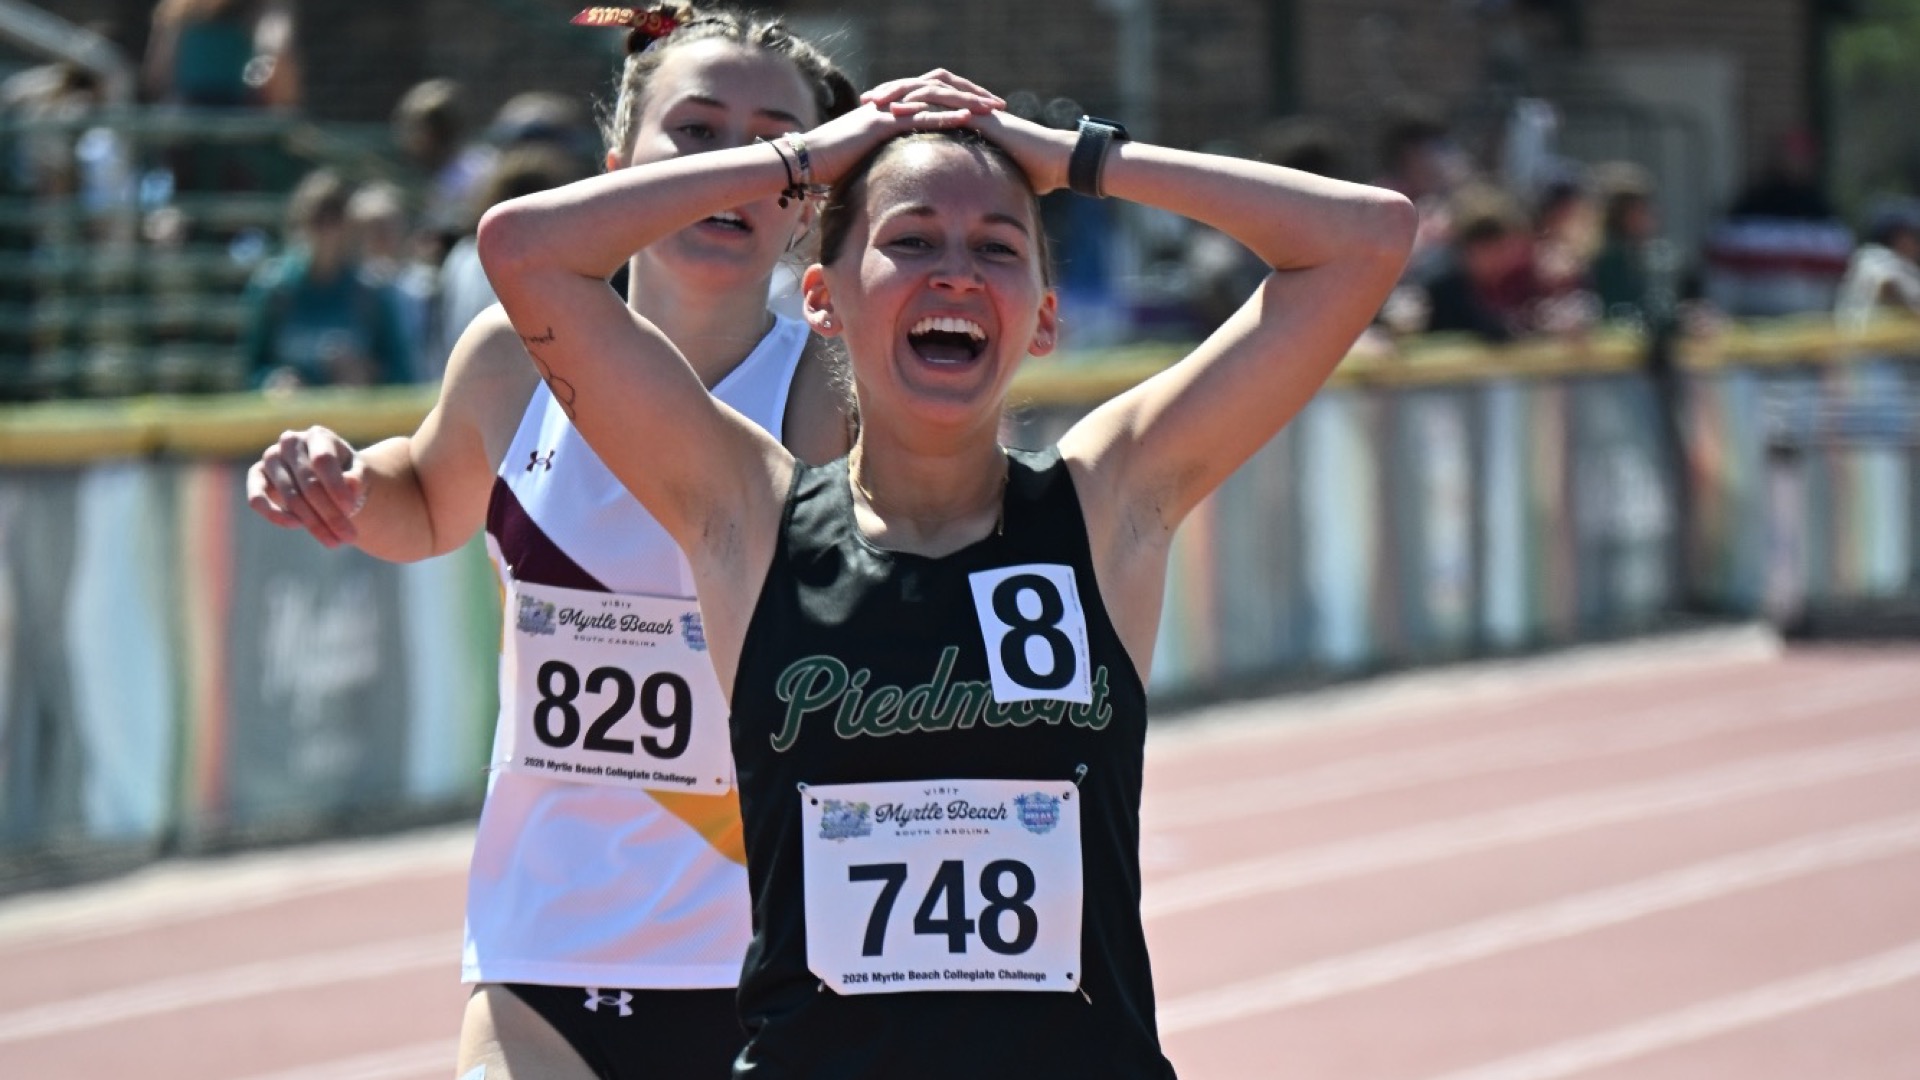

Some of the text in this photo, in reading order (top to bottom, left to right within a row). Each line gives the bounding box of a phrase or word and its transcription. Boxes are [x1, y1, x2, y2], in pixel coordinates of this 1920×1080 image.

[601, 600, 632, 609] VISIT
[558, 607, 617, 632] Myrtle
[620, 613, 674, 635] Beach
[991, 573, 1077, 691] 8
[573, 634, 657, 648] SOUTH CAROLINA
[533, 659, 693, 760] 829
[524, 757, 698, 786] 2026 Myrtle Beach Collegiate Challenge
[924, 787, 959, 796] VISIT
[875, 802, 943, 828] Myrtle
[947, 800, 1008, 821] Beach
[895, 828, 990, 837] SOUTH CAROLINA
[848, 858, 1038, 957] 748
[842, 968, 1047, 985] 2026 Myrtle Beach Collegiate Challenge
